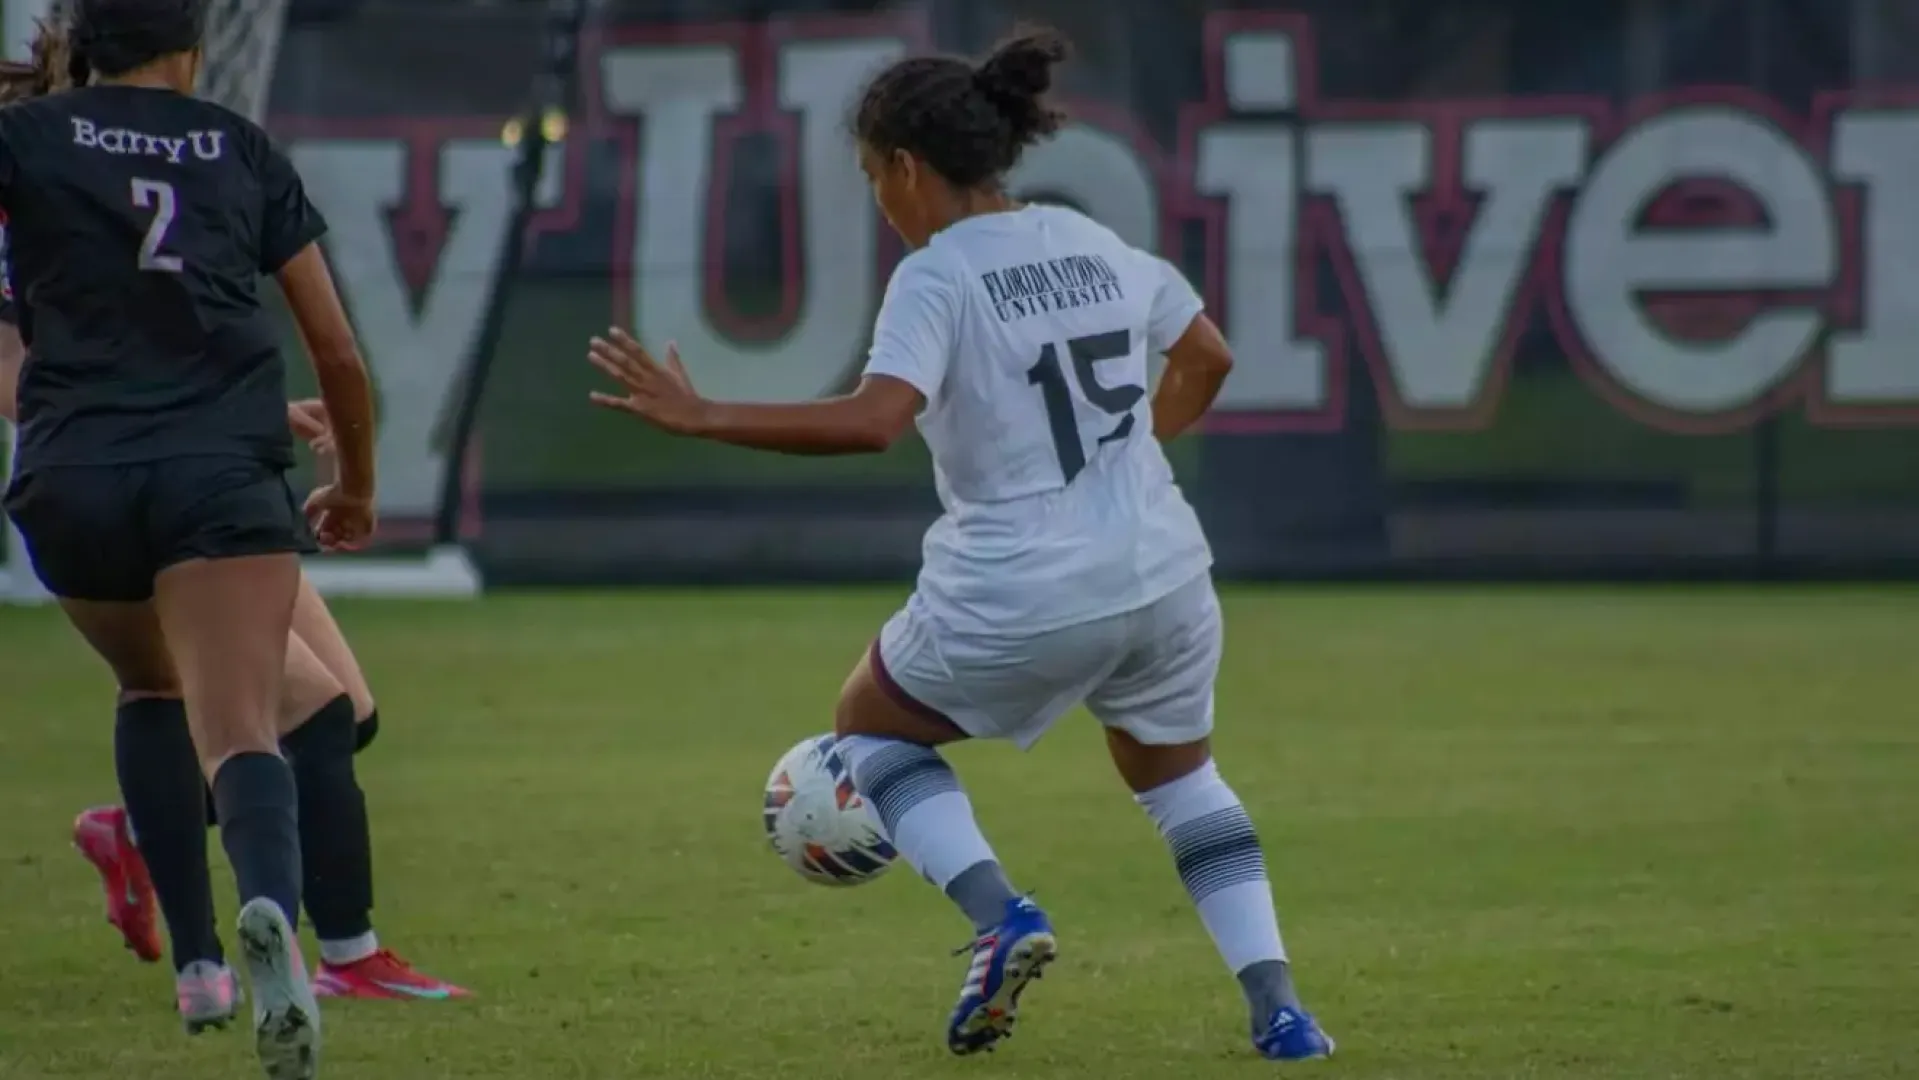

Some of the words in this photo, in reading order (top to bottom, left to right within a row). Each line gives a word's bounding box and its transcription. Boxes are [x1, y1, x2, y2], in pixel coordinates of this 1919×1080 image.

[70, 116, 185, 163] Barry
[188, 131, 223, 161] U
[131, 177, 183, 272] 2
[981, 262, 1053, 303] FLORIDA
[995, 282, 1124, 323] UNIVERSITY
[1027, 329, 1145, 487] 15
